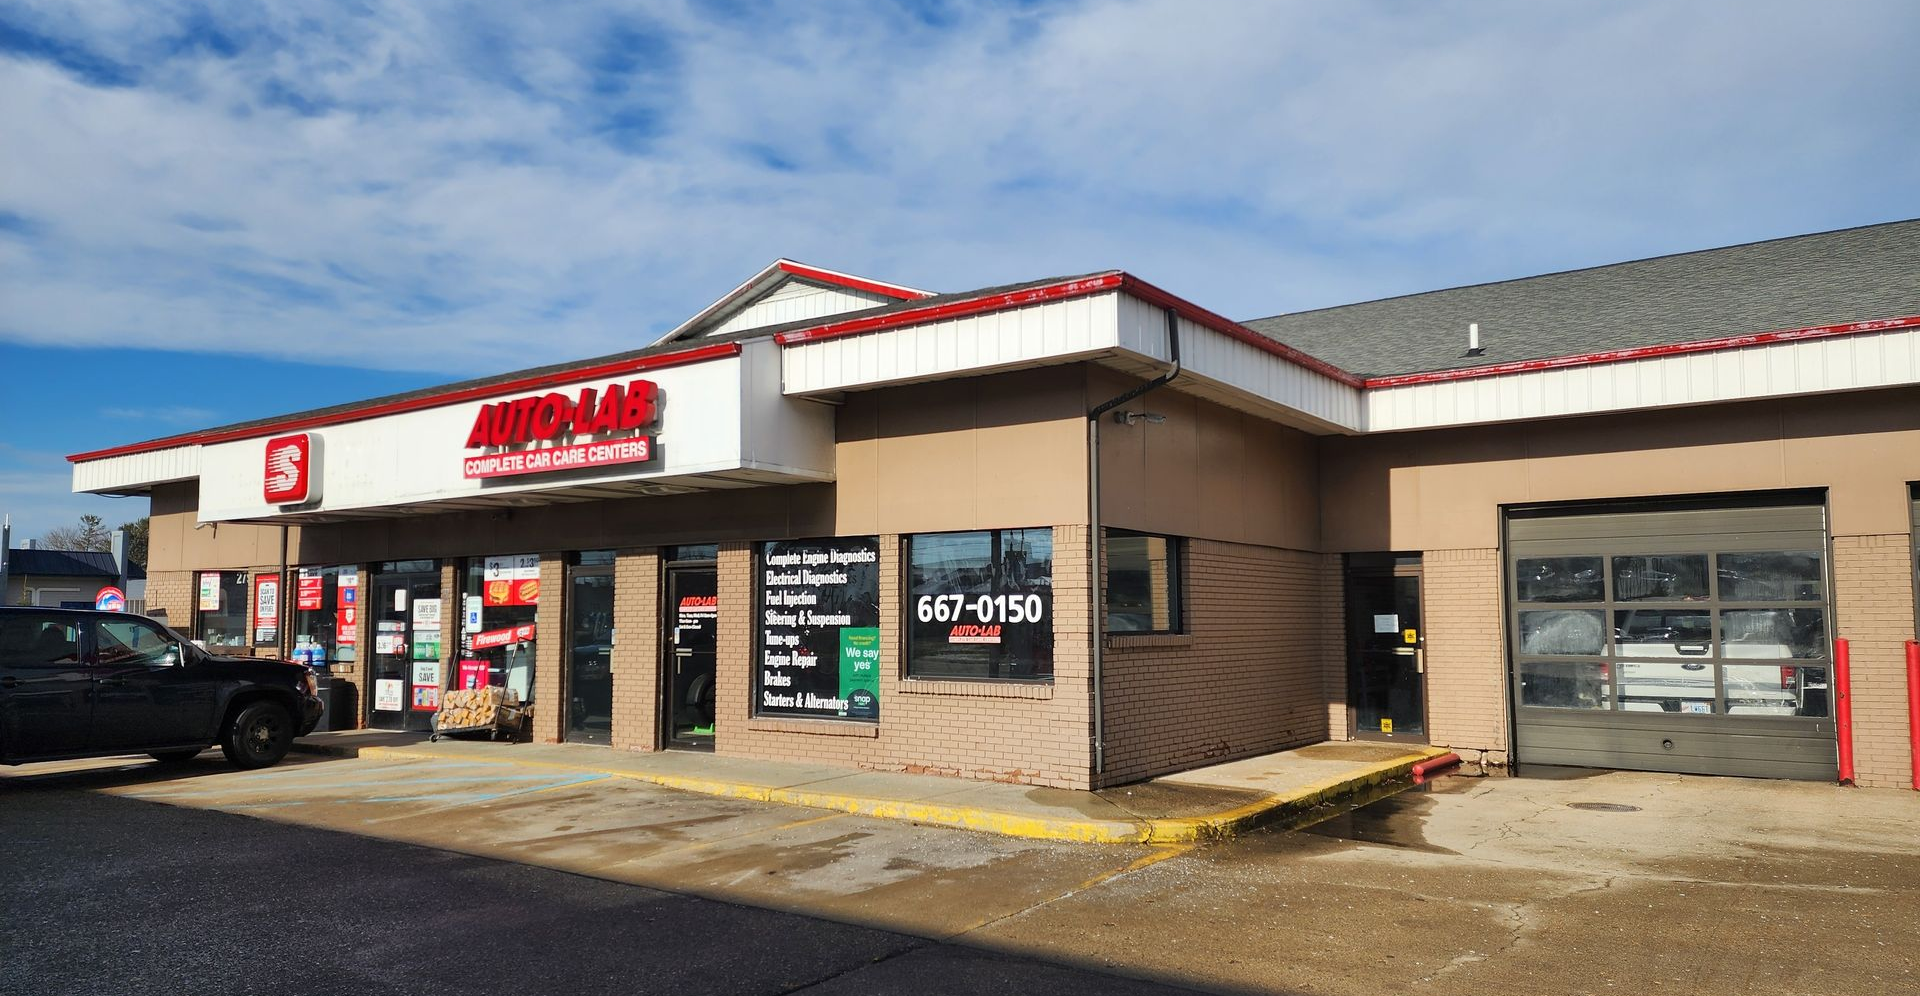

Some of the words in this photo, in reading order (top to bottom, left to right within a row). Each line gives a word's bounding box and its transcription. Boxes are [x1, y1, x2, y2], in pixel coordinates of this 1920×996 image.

[465, 380, 658, 448] AUTO-LAB
[465, 455, 523, 475] COMPLETE
[526, 451, 550, 469] CAR
[552, 447, 586, 466] CARE
[588, 440, 648, 461] CENTERS
[766, 550, 801, 567] Complete
[802, 549, 828, 566] Engine
[830, 547, 876, 565] Diagnostics
[766, 569, 801, 586] Electrical
[802, 569, 848, 587] Diagnostics
[260, 595, 275, 605] SAVE
[766, 590, 782, 606] Fuel
[783, 590, 817, 607] Injection
[917, 594, 1043, 623] 667-0150
[765, 609, 797, 627] Steering
[798, 610, 806, 625] &
[807, 610, 851, 628] Suspension
[476, 630, 512, 646] Firewood
[765, 630, 799, 648] Tune-ups
[764, 650, 790, 668] Engine
[792, 650, 818, 669] Repair
[846, 647, 861, 658] We
[862, 649, 879, 660] say
[854, 661, 871, 672] yes
[418, 672, 434, 683] SAVE
[764, 670, 791, 687] Brakes
[763, 691, 794, 708] Starters
[795, 692, 803, 708] &
[804, 693, 849, 710] Alternators
